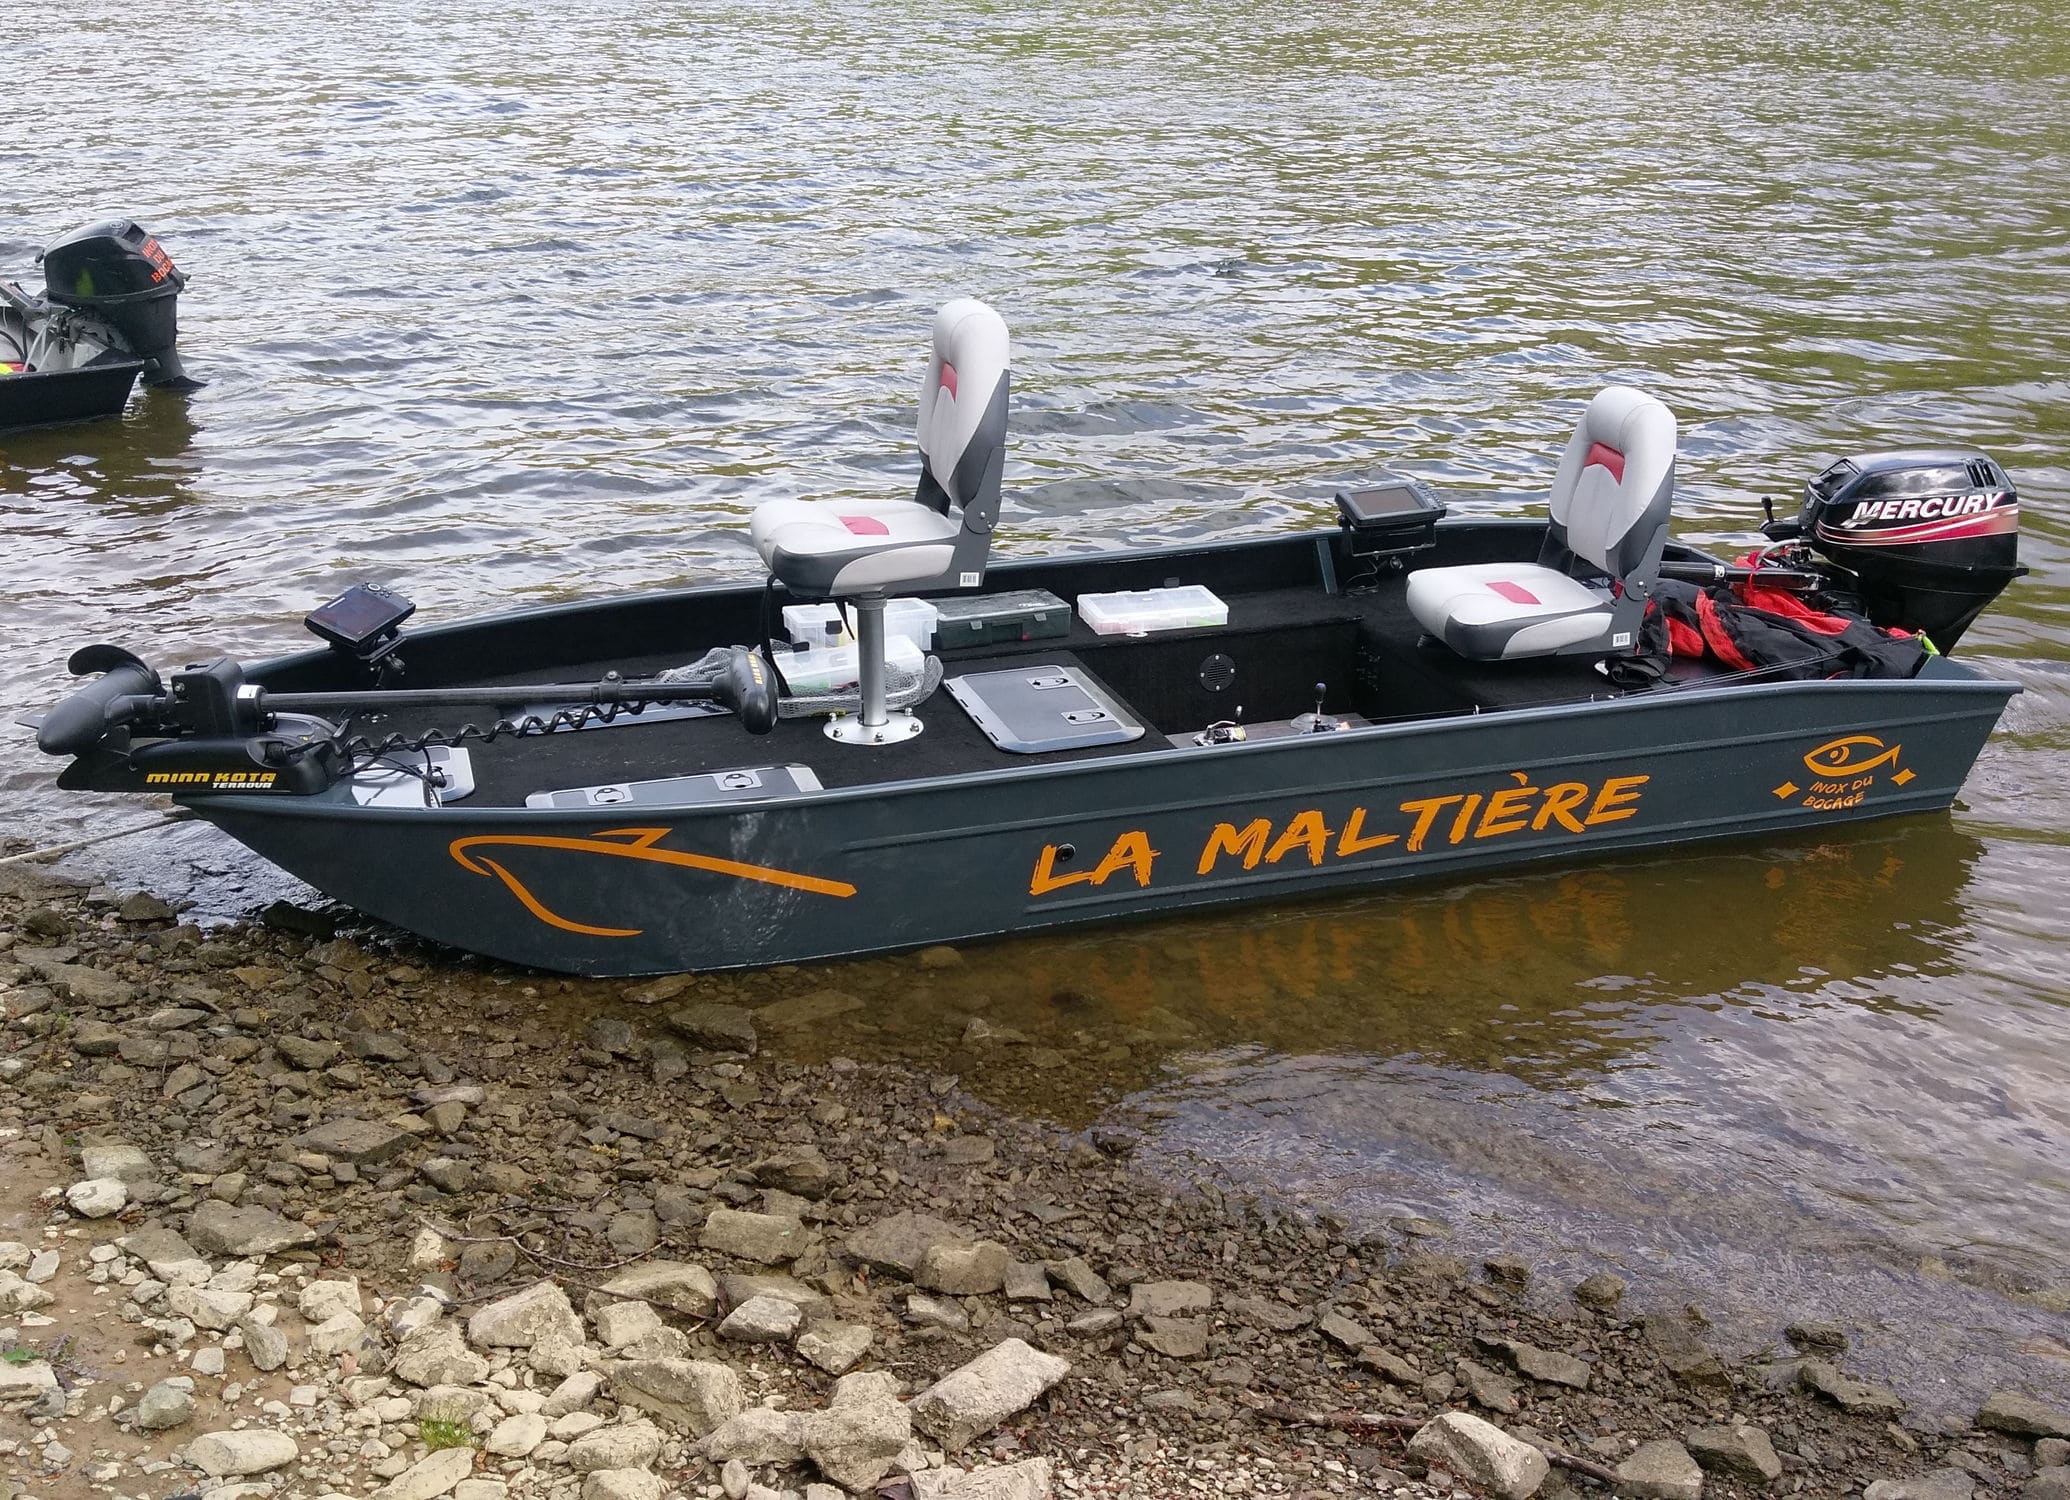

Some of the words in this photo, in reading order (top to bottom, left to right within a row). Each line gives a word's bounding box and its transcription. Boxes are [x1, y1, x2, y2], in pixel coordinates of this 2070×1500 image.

[1851, 491, 2005, 521] MERCURY
[214, 772, 277, 782] KOTA
[1809, 781, 1848, 793] INOX
[1851, 775, 1873, 791] DU
[1802, 791, 1865, 810] BOCAGE
[1030, 831, 1160, 895] LA
[1197, 772, 1650, 875] MALTIÈRE
